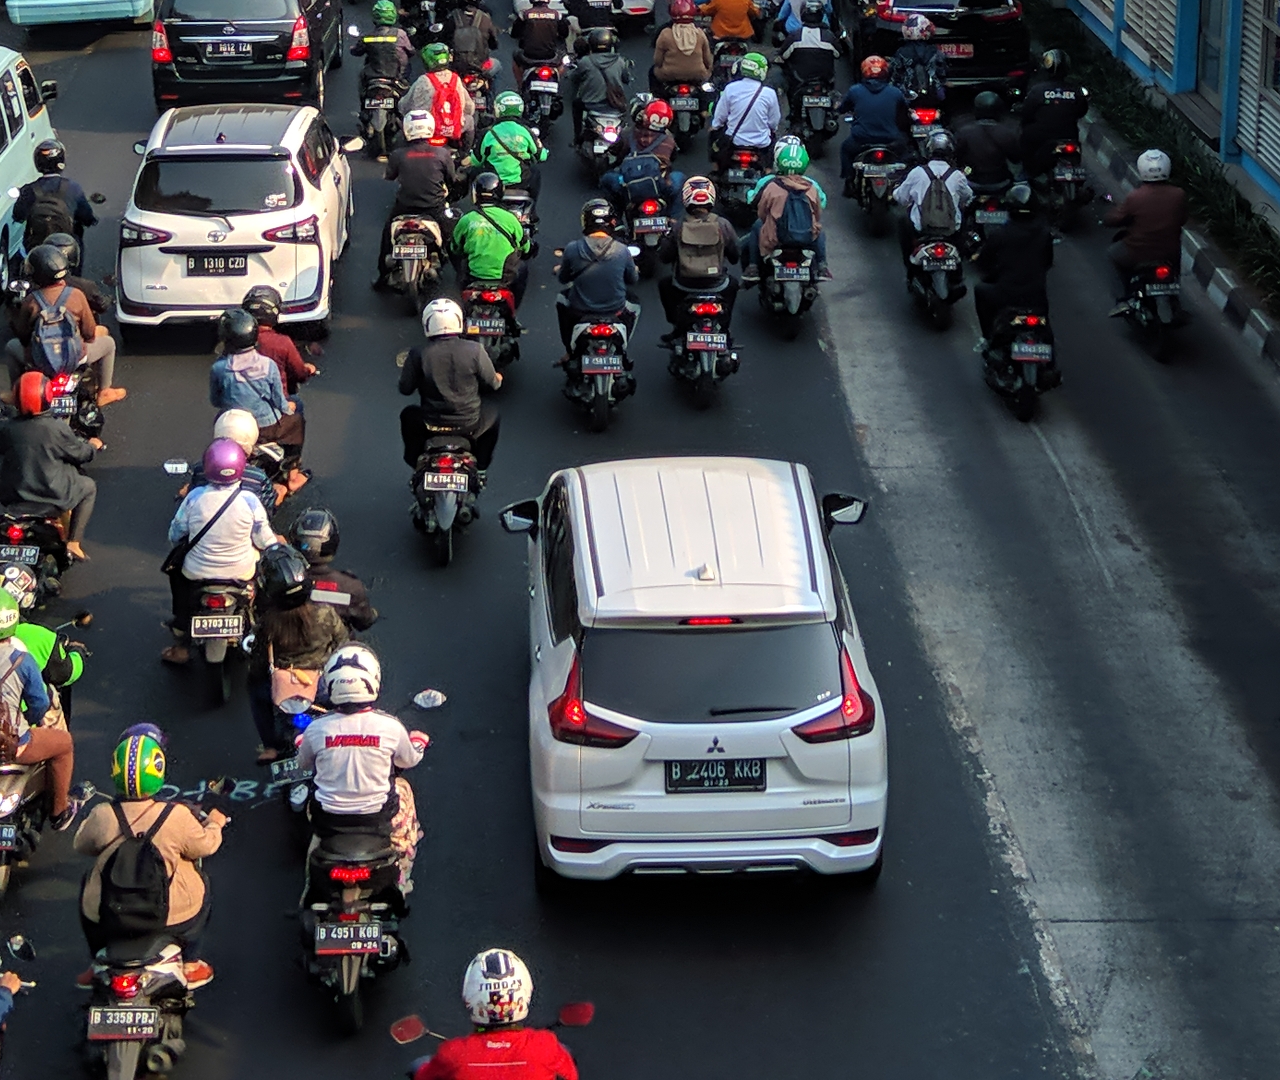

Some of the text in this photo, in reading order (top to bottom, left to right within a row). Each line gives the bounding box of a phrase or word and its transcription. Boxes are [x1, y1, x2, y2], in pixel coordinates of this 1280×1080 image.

[1062, 91, 1075, 100] JEK
[781, 158, 803, 169] Grab
[188, 257, 195, 269] B
[203, 257, 225, 269] 1310
[5, 612, 17, 625] JEK
[672, 759, 761, 780] B 2406 KKB
[2, 827, 15, 837] RD
[319, 928, 326, 939] B
[330, 927, 355, 939] 4951
[94, 1011, 155, 1025] B 3358 PBJ
